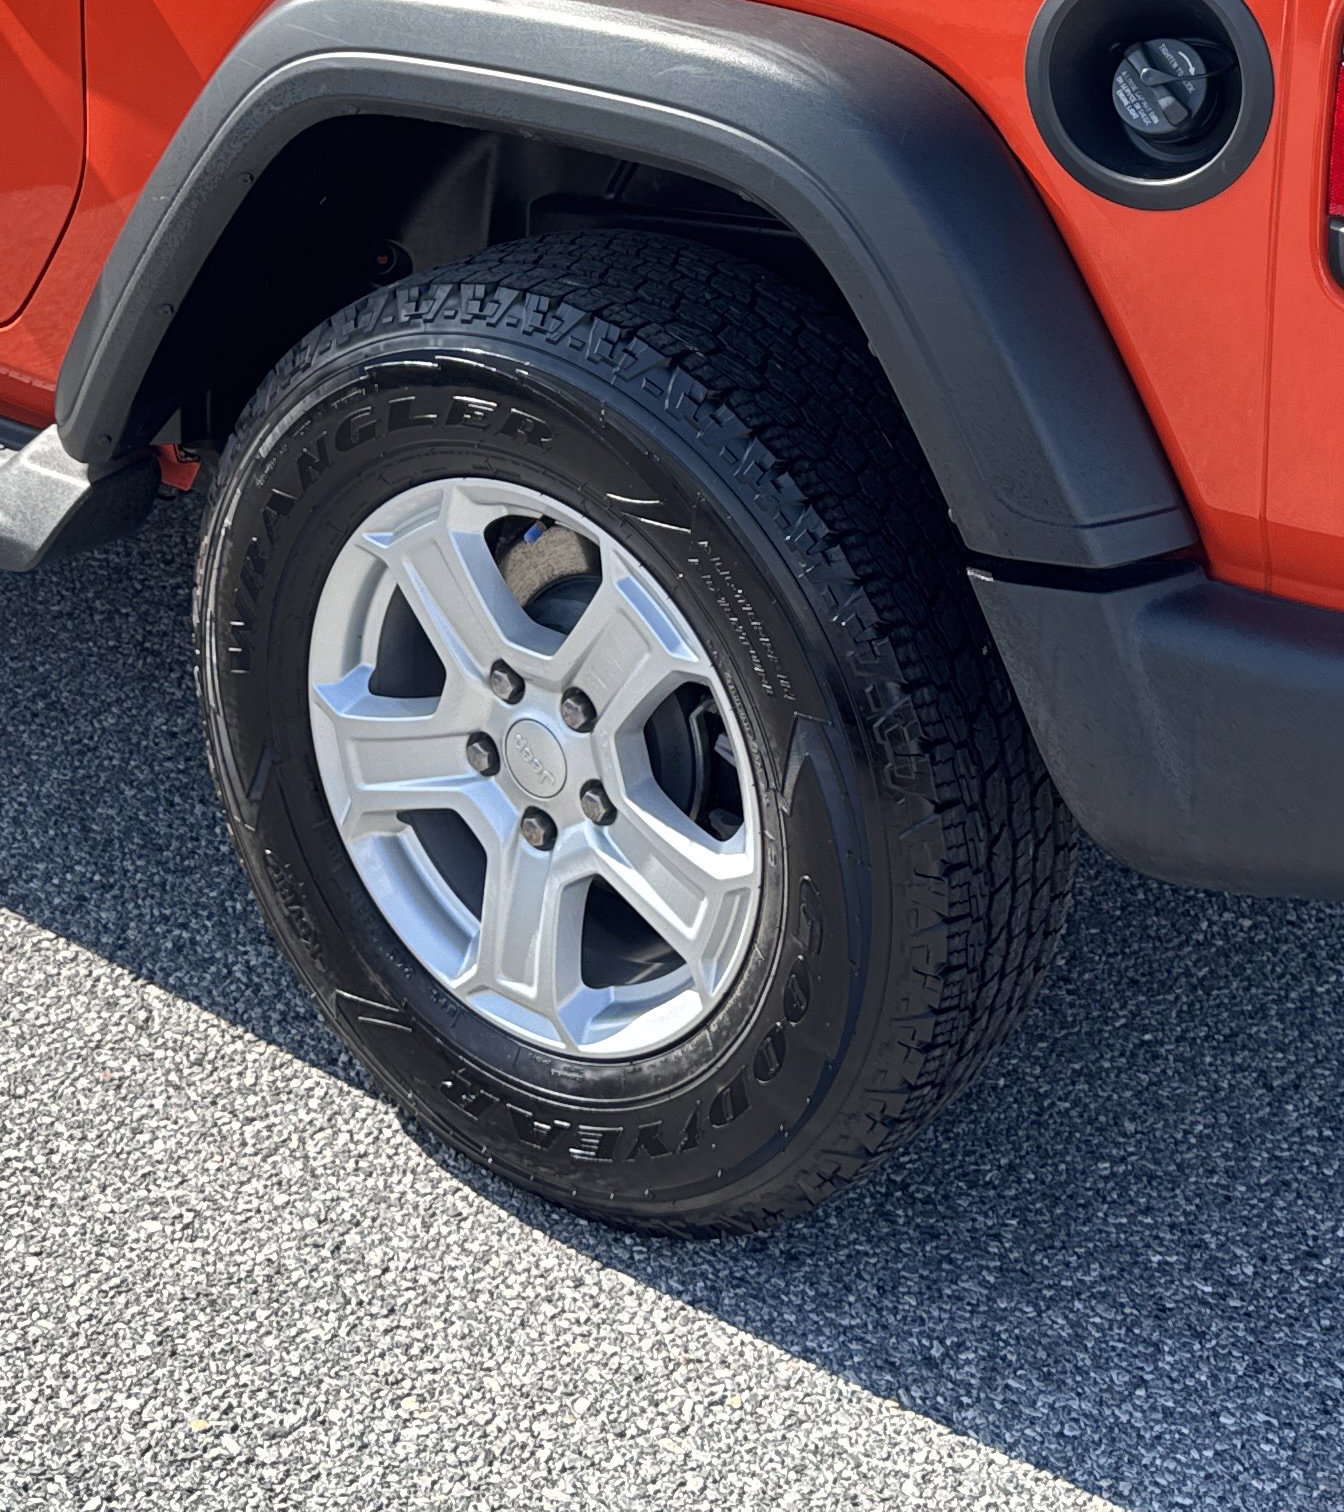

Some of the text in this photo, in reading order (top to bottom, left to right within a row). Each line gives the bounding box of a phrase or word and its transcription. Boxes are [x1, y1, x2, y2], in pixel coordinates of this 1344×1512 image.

[228, 395, 553, 674] WRANGLER
[515, 734, 555, 786] Jeep
[440, 875, 824, 1162] GOODYEAR
